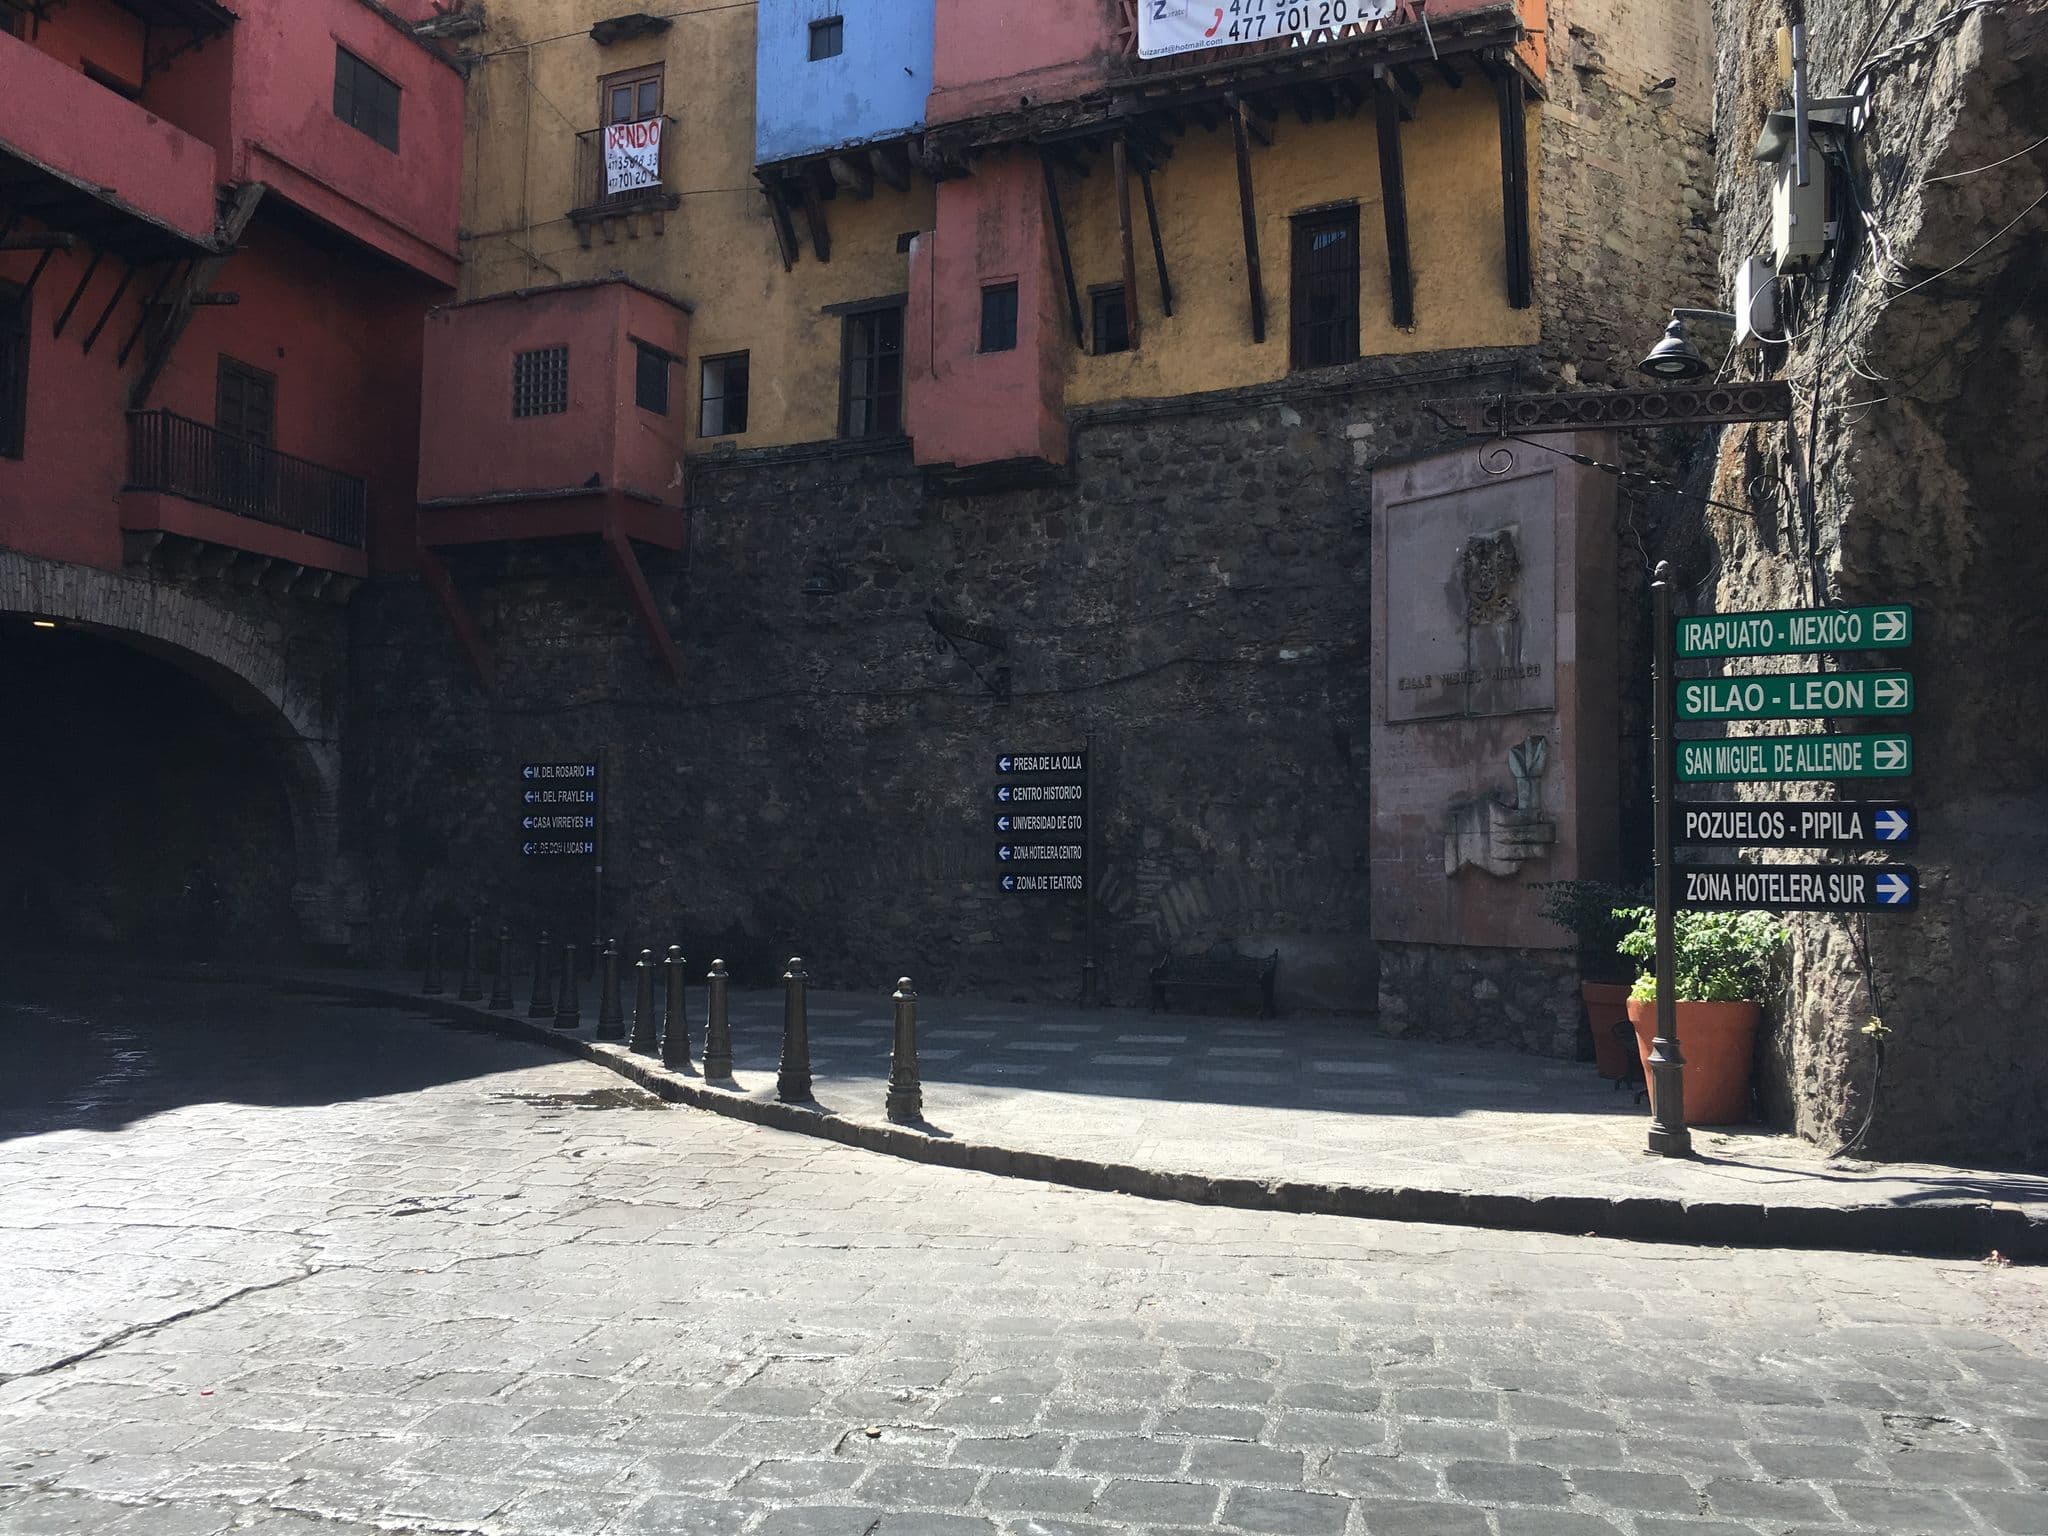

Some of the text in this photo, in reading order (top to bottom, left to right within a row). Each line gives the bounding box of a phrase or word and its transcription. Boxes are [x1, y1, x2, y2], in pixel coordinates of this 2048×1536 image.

[1229, 15, 1266, 41] 477
[1276, 5, 1309, 33] 701
[1319, 0, 1346, 25] 20
[608, 121, 660, 149] VENDO
[619, 171, 632, 188] 701
[636, 170, 647, 184] 20
[1685, 619, 1774, 651] IRAPUATO
[1789, 614, 1862, 646] MEXICO
[1685, 684, 1764, 713] SILAO
[1789, 680, 1864, 710] LEON
[1013, 755, 1082, 770] PRESA DE LA OLLA
[1685, 742, 1862, 775] SAN MIGUEL DE ALLENDE
[541, 766, 555, 778] DEL
[555, 765, 585, 778] ROSARIO
[542, 790, 557, 803] DEL
[557, 790, 585, 803] FRAYLE
[1012, 785, 1082, 801] CENTRO HISTORICO
[533, 816, 551, 828] CASA
[551, 816, 584, 828] VIRREYES
[1012, 815, 1082, 830] UNIVERSIDAD DE GTO
[1686, 811, 1784, 839] POZUELOS
[1802, 811, 1863, 839] PIPILA
[1013, 845, 1082, 860] ZONA HOTELERA CENTRO
[1016, 875, 1083, 890] ZONA DE TEATROS
[1686, 873, 1866, 903] ZONA HOTELERA SUR
